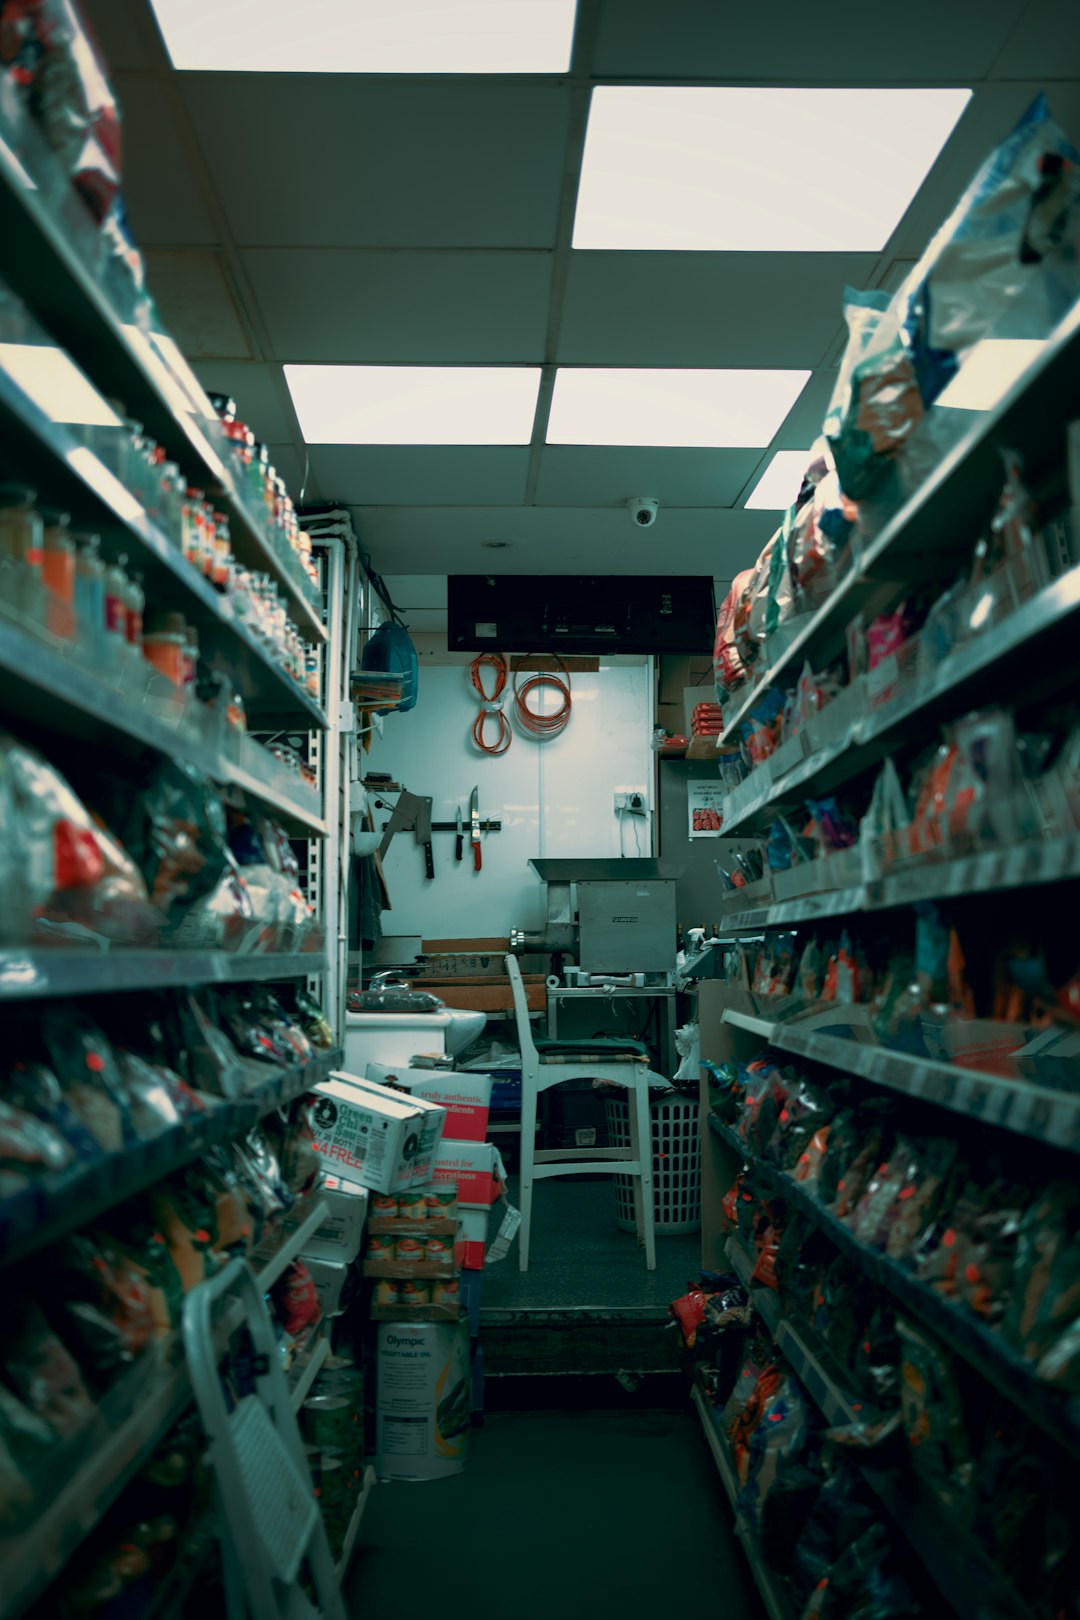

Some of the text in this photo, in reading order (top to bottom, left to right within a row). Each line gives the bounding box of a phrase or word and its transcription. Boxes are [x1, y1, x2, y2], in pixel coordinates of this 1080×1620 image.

[421, 1090, 482, 1104] truly authentic
[339, 1104, 373, 1124] Green
[329, 1144, 365, 1170] FREE
[386, 1335, 425, 1348] Olympic
